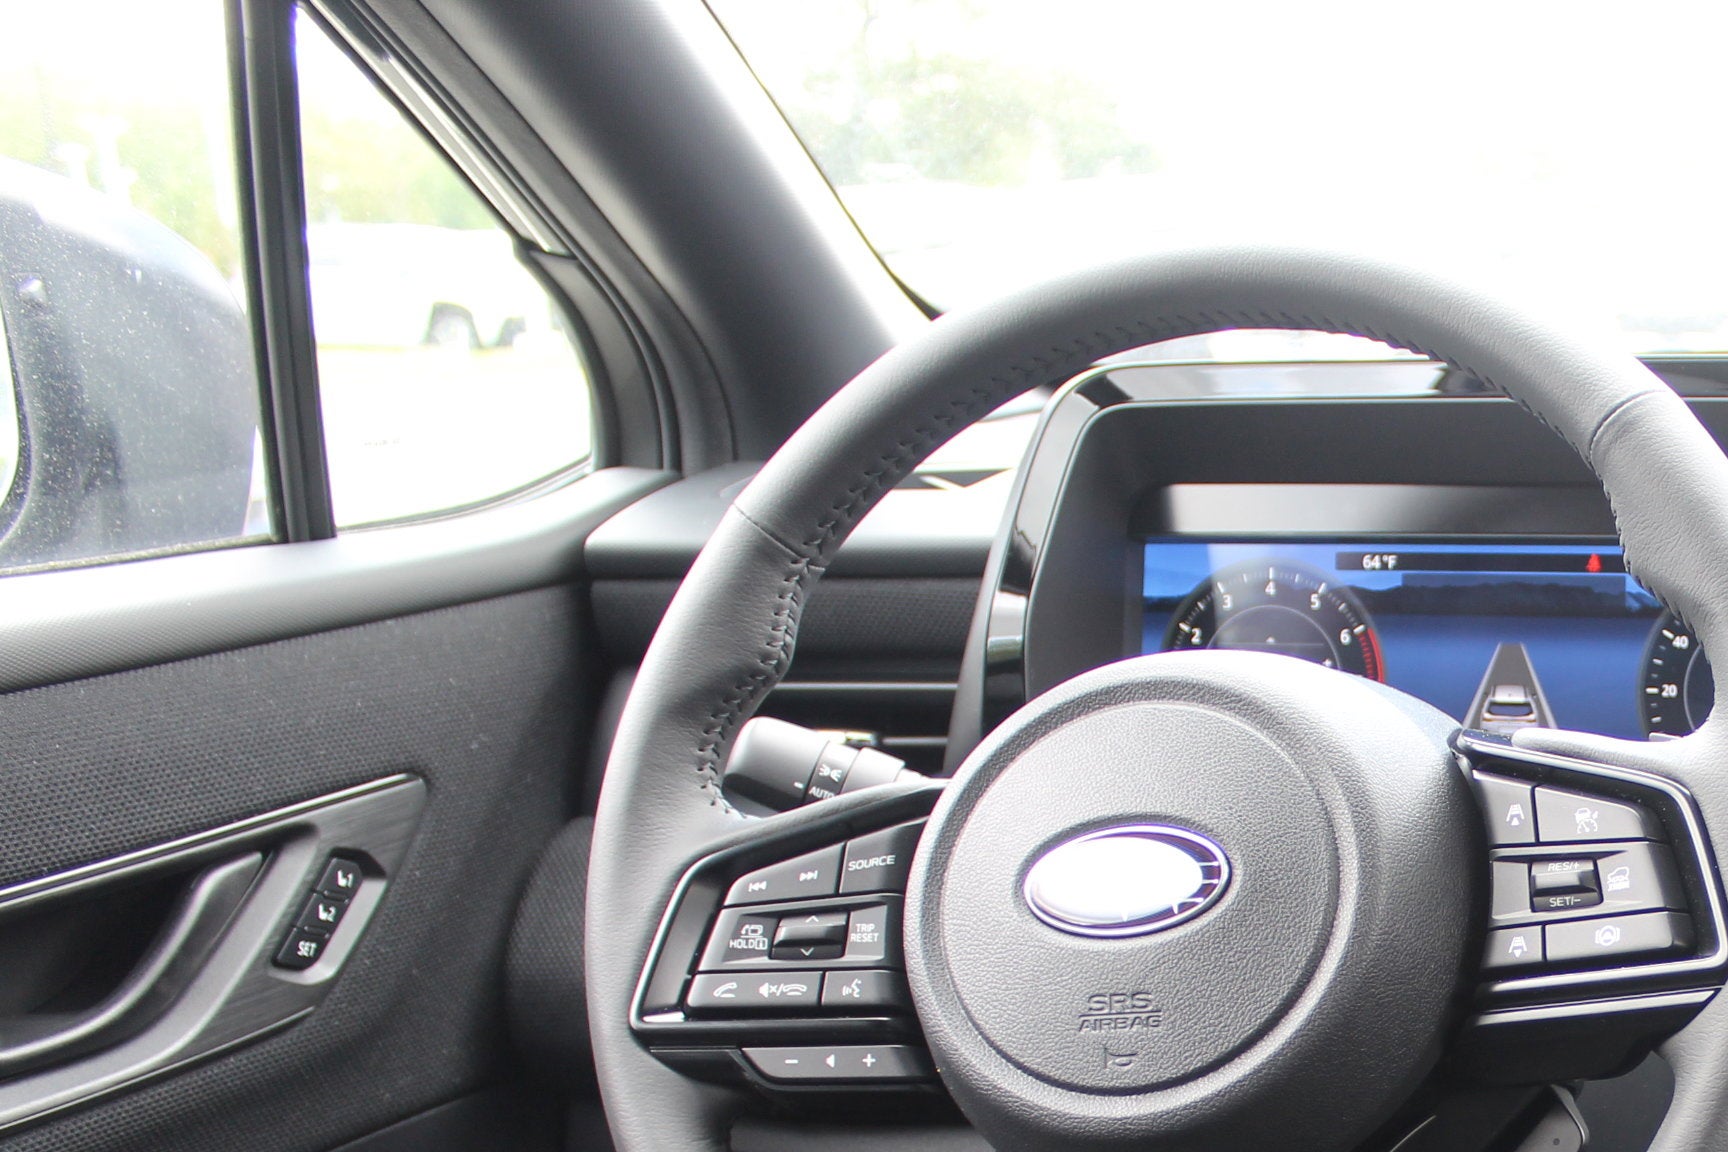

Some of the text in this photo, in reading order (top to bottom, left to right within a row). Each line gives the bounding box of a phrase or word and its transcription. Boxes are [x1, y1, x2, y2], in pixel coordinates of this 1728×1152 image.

[1265, 581, 1276, 596] 4
[1222, 594, 1234, 610] 3
[1310, 594, 1322, 610] 5
[1191, 628, 1203, 645] 2
[1339, 628, 1351, 646] 6
[1672, 635, 1690, 650] 40
[1661, 684, 1678, 698] 20
[848, 854, 896, 871] SOURCE
[855, 923, 875, 933] TRIP
[729, 938, 755, 949] HOLD
[850, 932, 879, 943] RESET
[297, 940, 317, 958] SET
[1087, 991, 1154, 1012] SRS
[1079, 1016, 1162, 1032] AIRBAG
